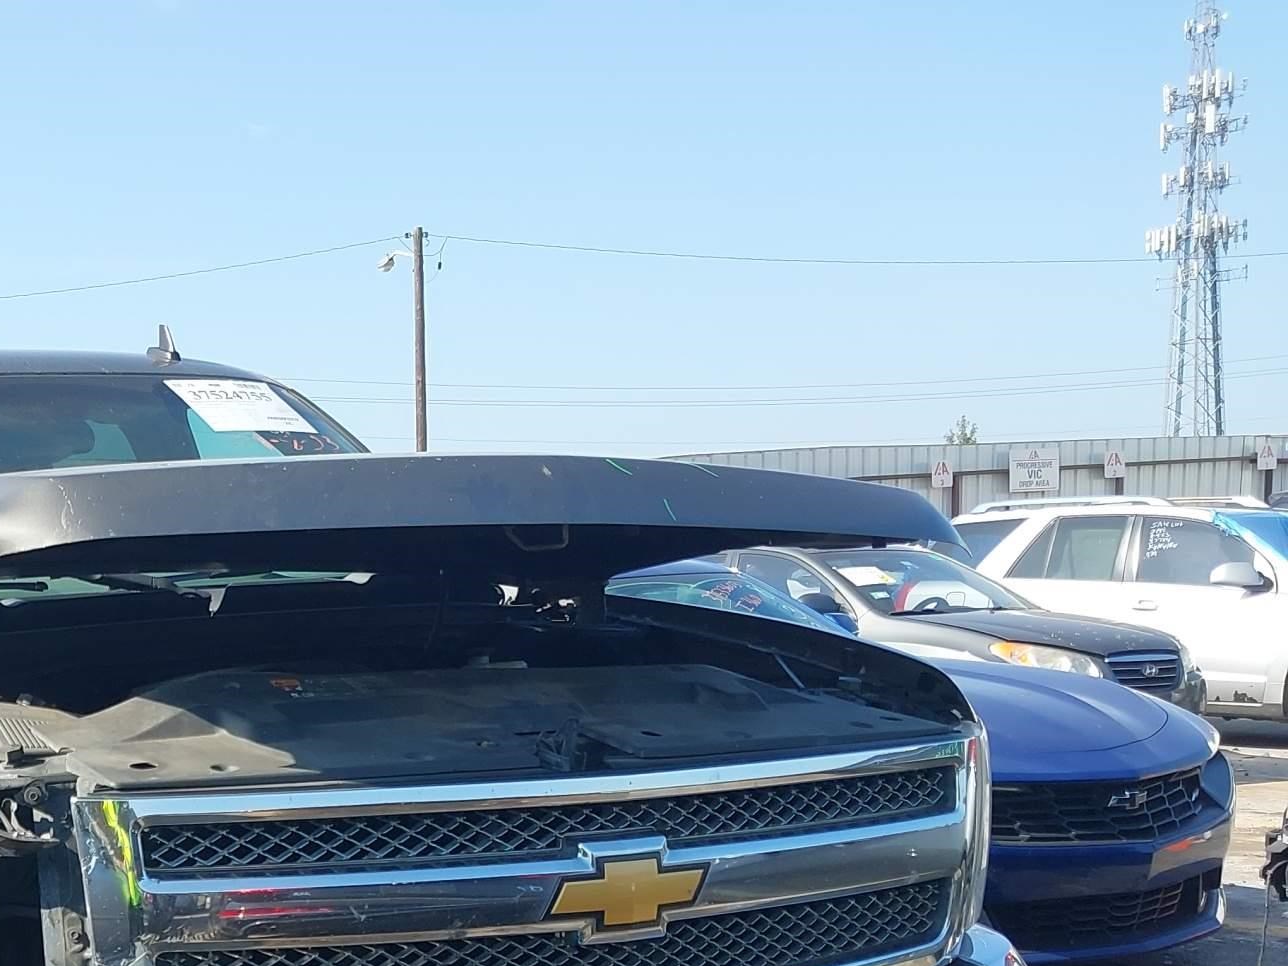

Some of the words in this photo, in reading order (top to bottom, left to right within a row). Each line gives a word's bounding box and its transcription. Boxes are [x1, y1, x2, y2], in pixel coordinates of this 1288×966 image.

[188, 389, 273, 402] 37524755
[1016, 461, 1053, 470] PROGRESSIVE
[1027, 469, 1042, 479] VIC
[1018, 480, 1033, 488] DROP
[1035, 479, 1050, 487] AREA
